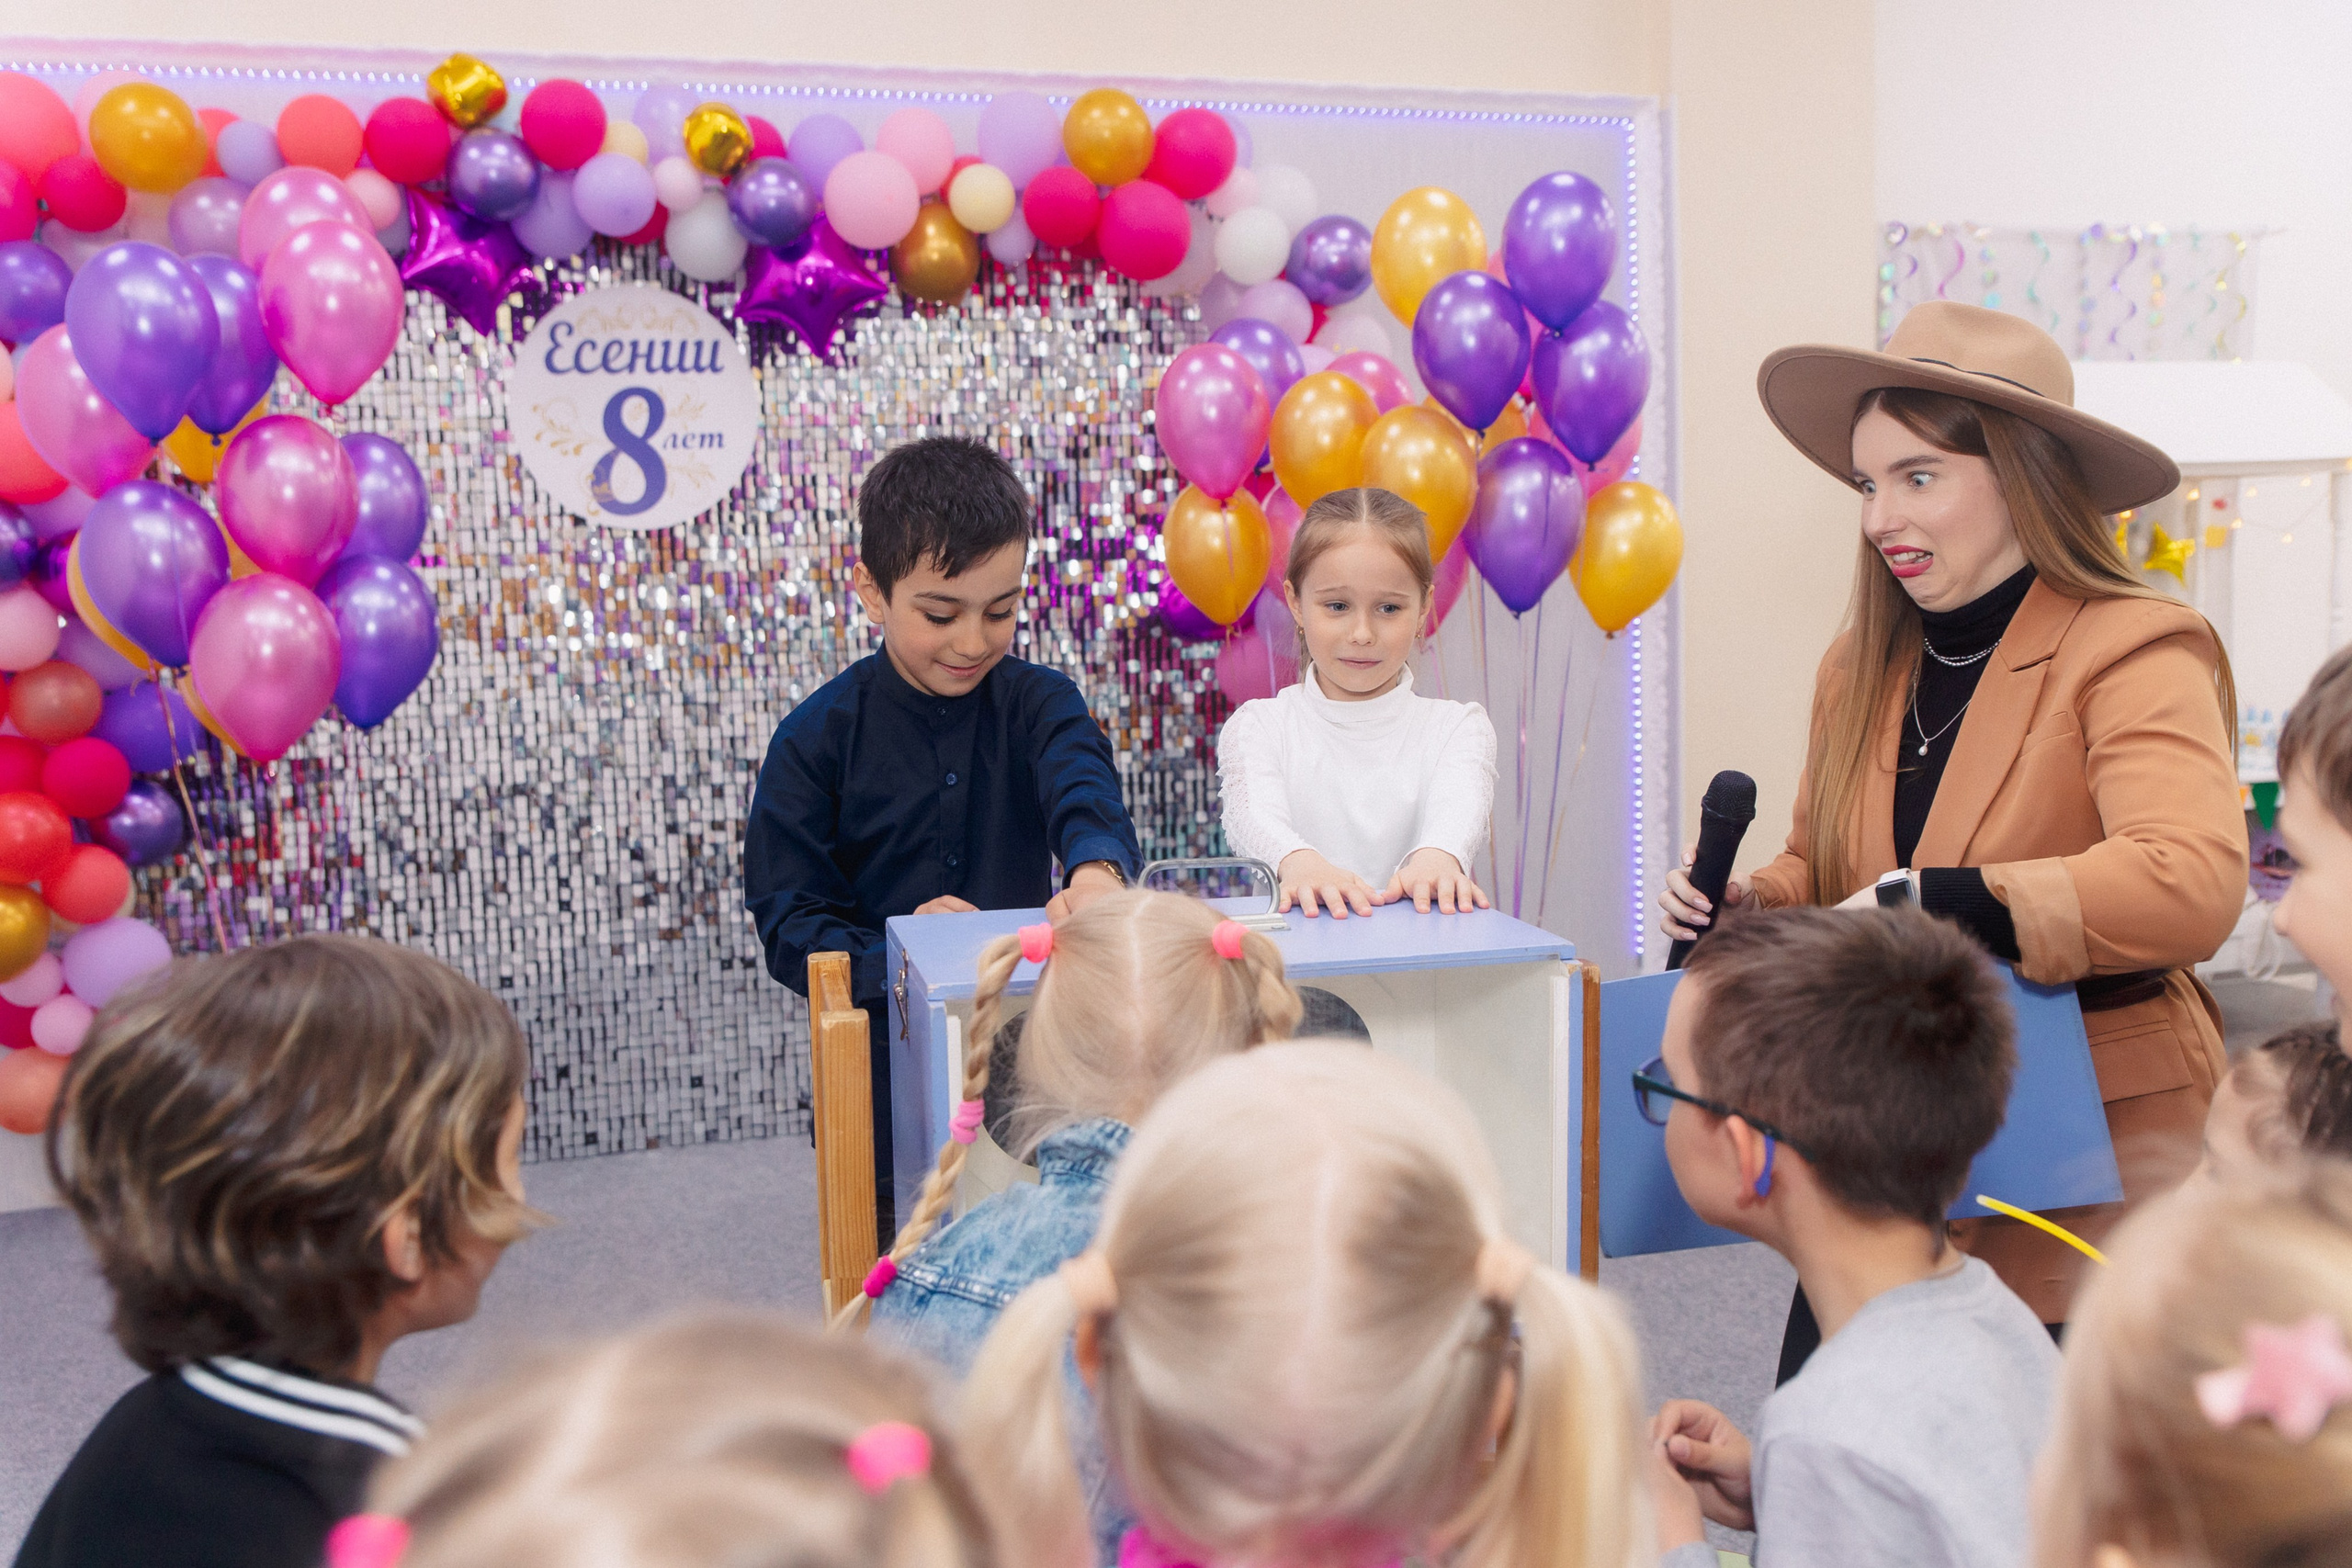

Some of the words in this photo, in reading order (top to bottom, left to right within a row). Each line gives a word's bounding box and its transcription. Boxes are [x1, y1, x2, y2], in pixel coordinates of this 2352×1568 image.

[544, 321, 725, 375] Есении
[591, 387, 667, 516] 8
[662, 432, 724, 449] лет
